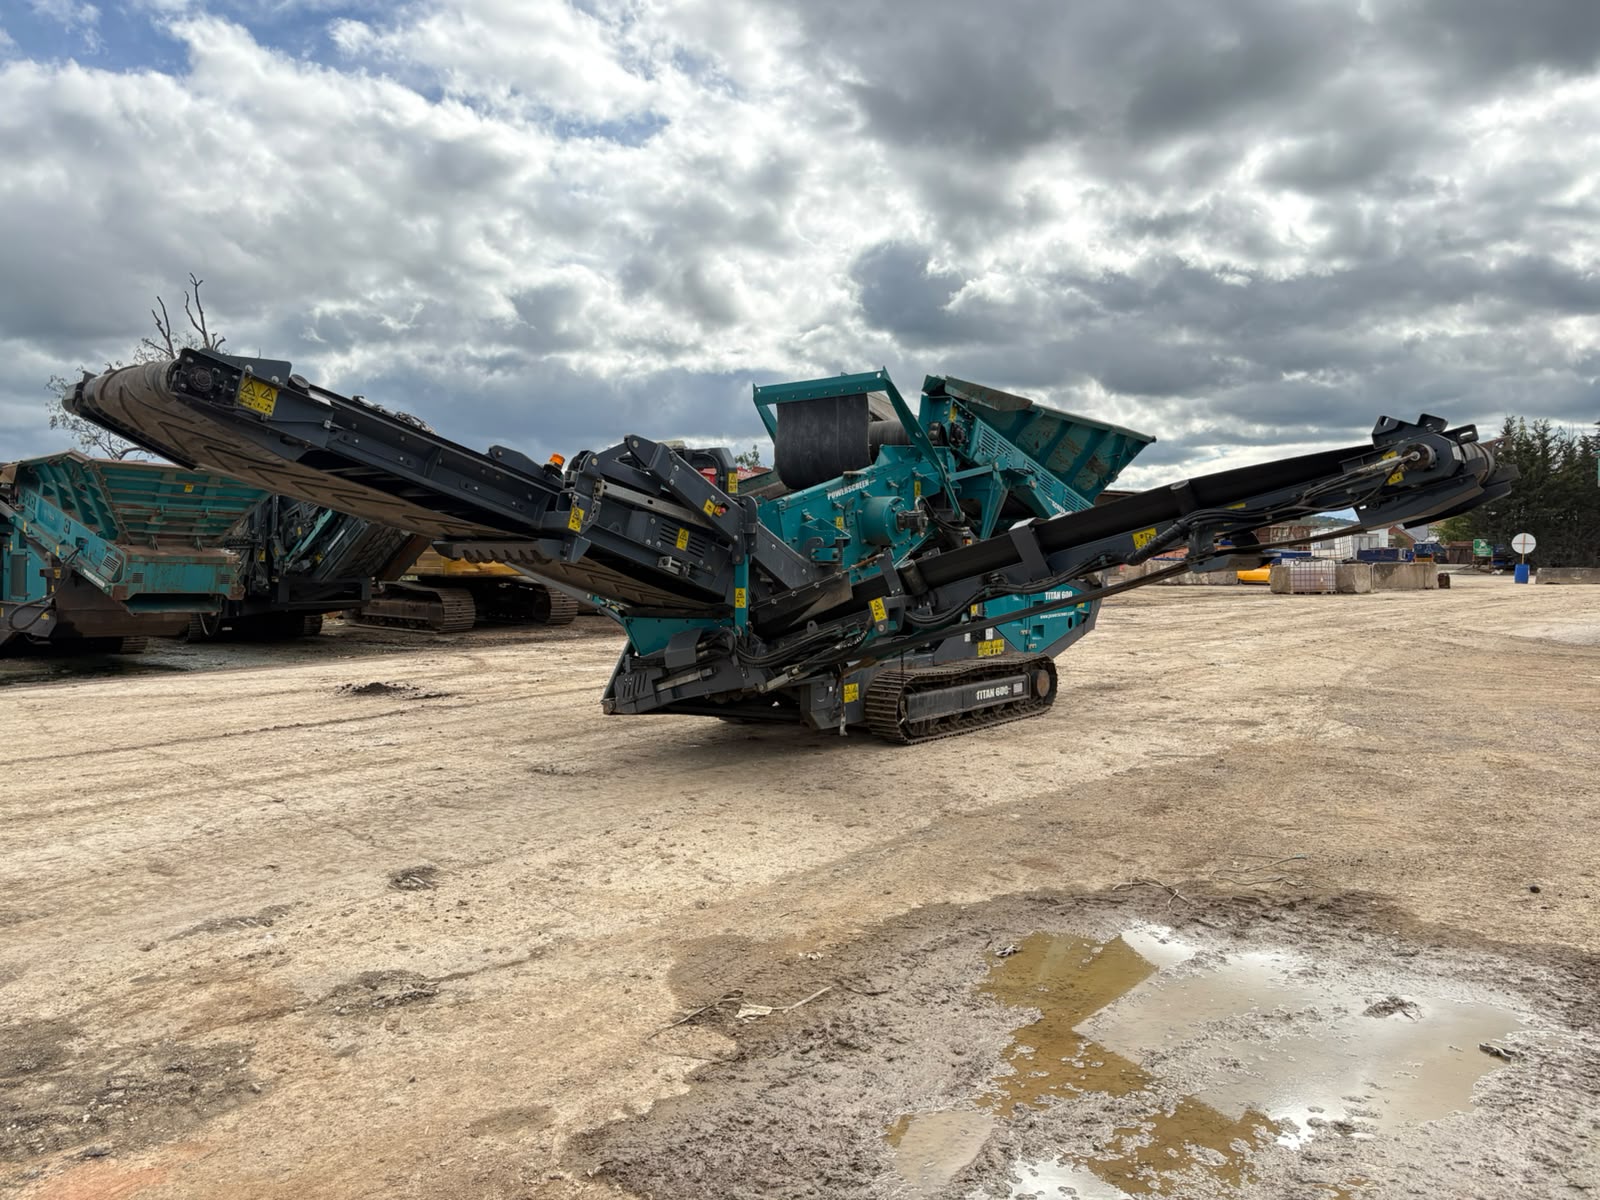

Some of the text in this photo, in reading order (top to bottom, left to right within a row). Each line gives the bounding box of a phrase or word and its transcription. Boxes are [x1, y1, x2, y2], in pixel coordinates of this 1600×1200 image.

[827, 479, 869, 500] POWERSCREEN
[1045, 590, 1073, 600] TITAN 600
[976, 685, 1009, 700] TITAN 600
